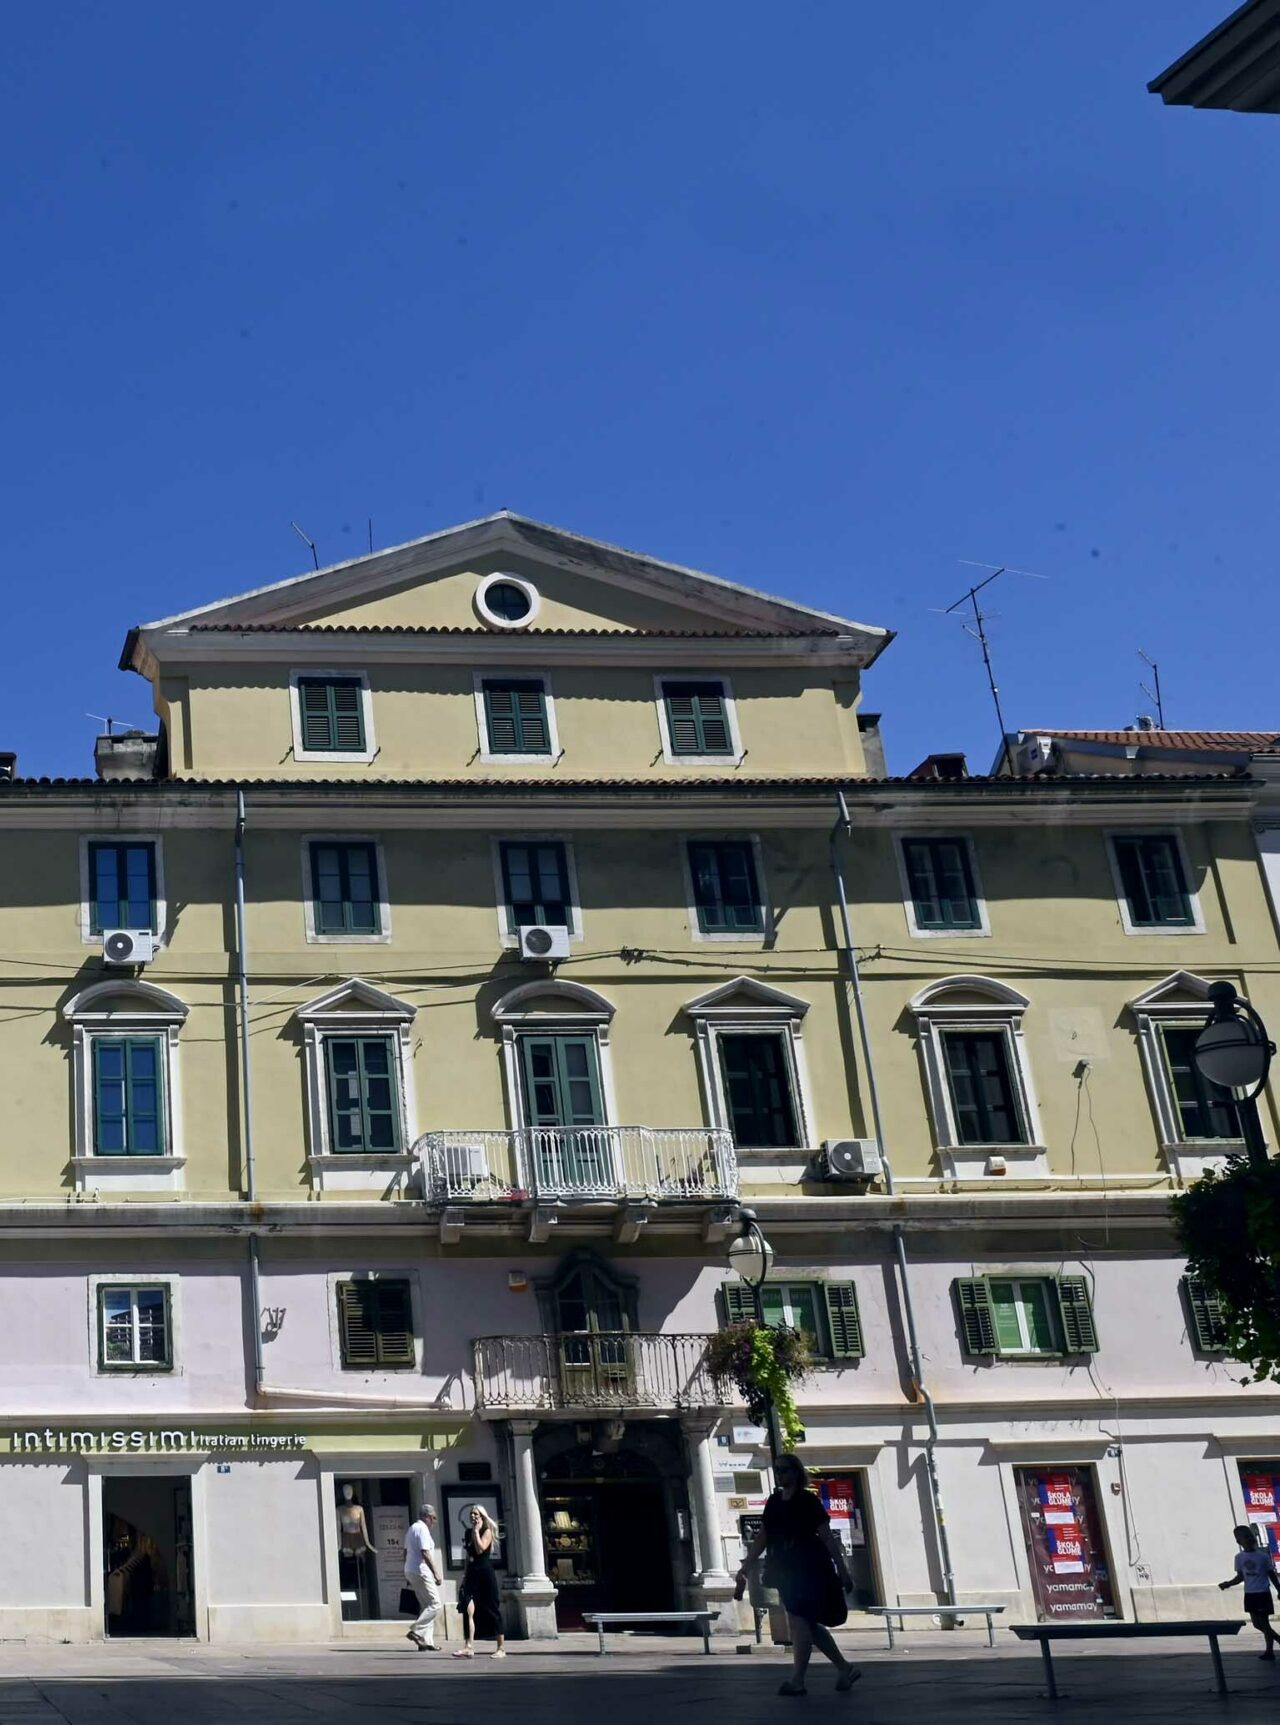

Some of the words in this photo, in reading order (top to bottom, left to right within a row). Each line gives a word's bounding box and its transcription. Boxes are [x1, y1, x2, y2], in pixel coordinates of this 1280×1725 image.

[13, 1428, 195, 1448] intimissimi
[250, 1433, 307, 1447] lingerie
[1047, 1490, 1071, 1499] ŠKOLA
[1056, 1540, 1080, 1550] ŠKOLA
[1050, 1603, 1098, 1612] yamamay
